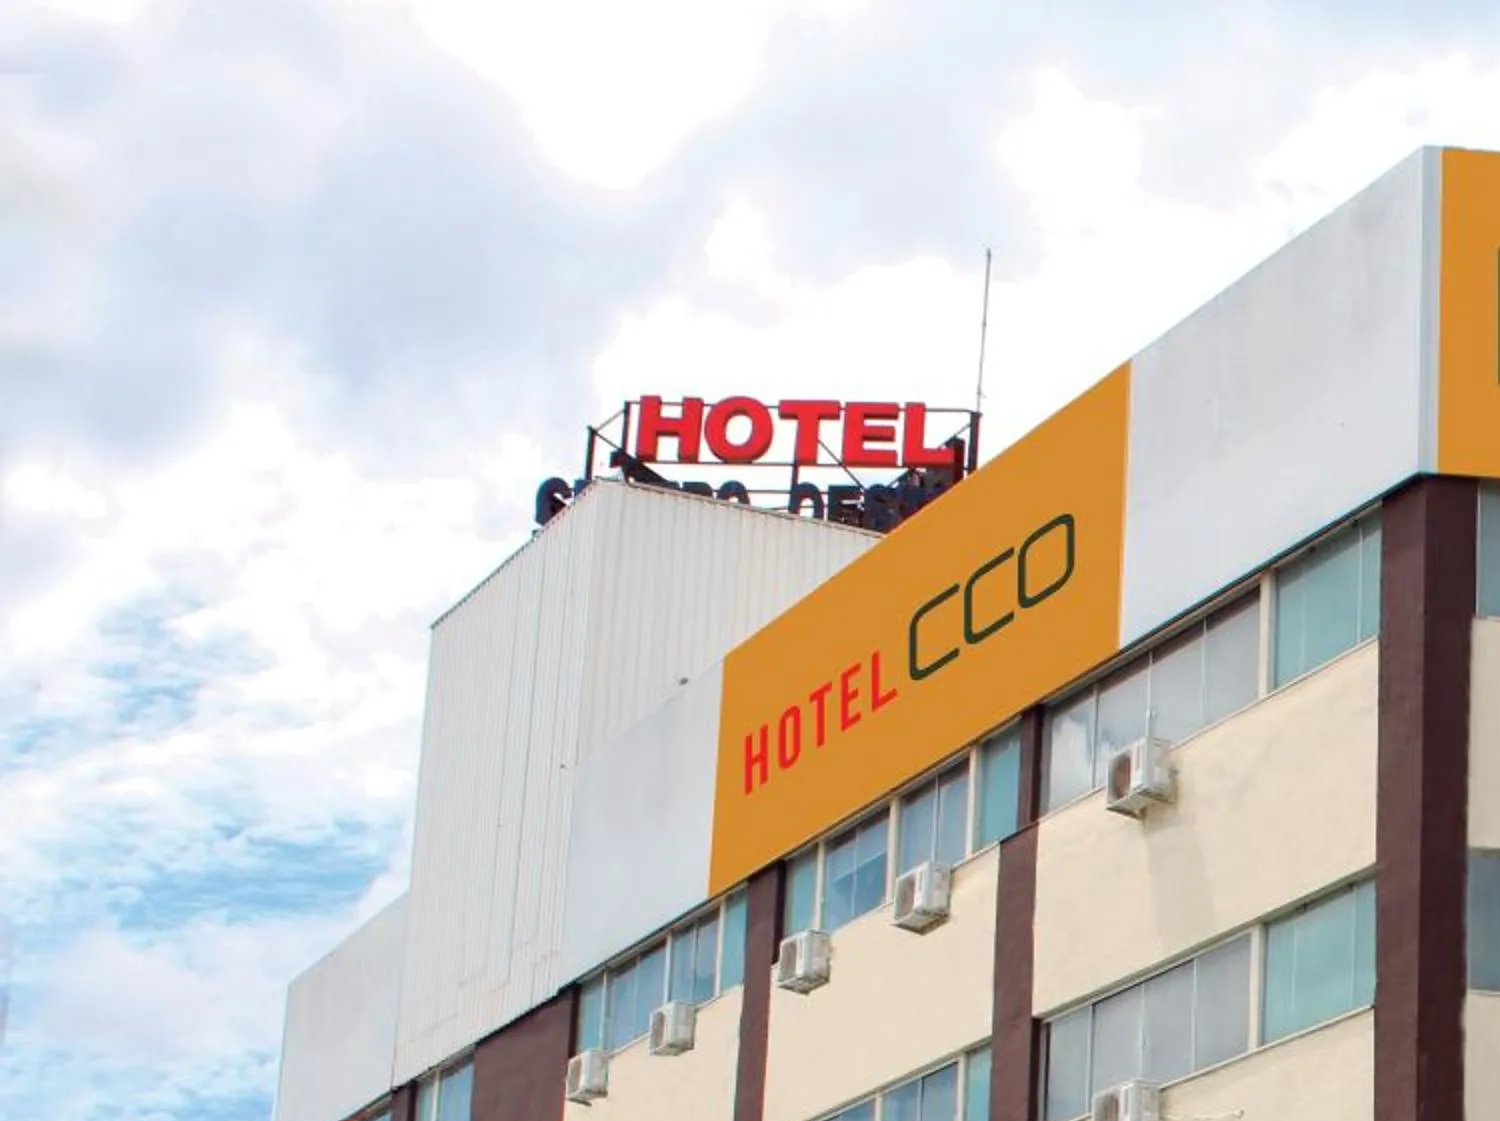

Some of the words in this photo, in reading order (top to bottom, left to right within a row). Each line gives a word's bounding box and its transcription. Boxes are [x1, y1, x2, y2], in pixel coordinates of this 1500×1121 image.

[635, 395, 956, 468] HOTEL
[744, 651, 898, 795] HOTEL
[908, 513, 1075, 681] CCO
